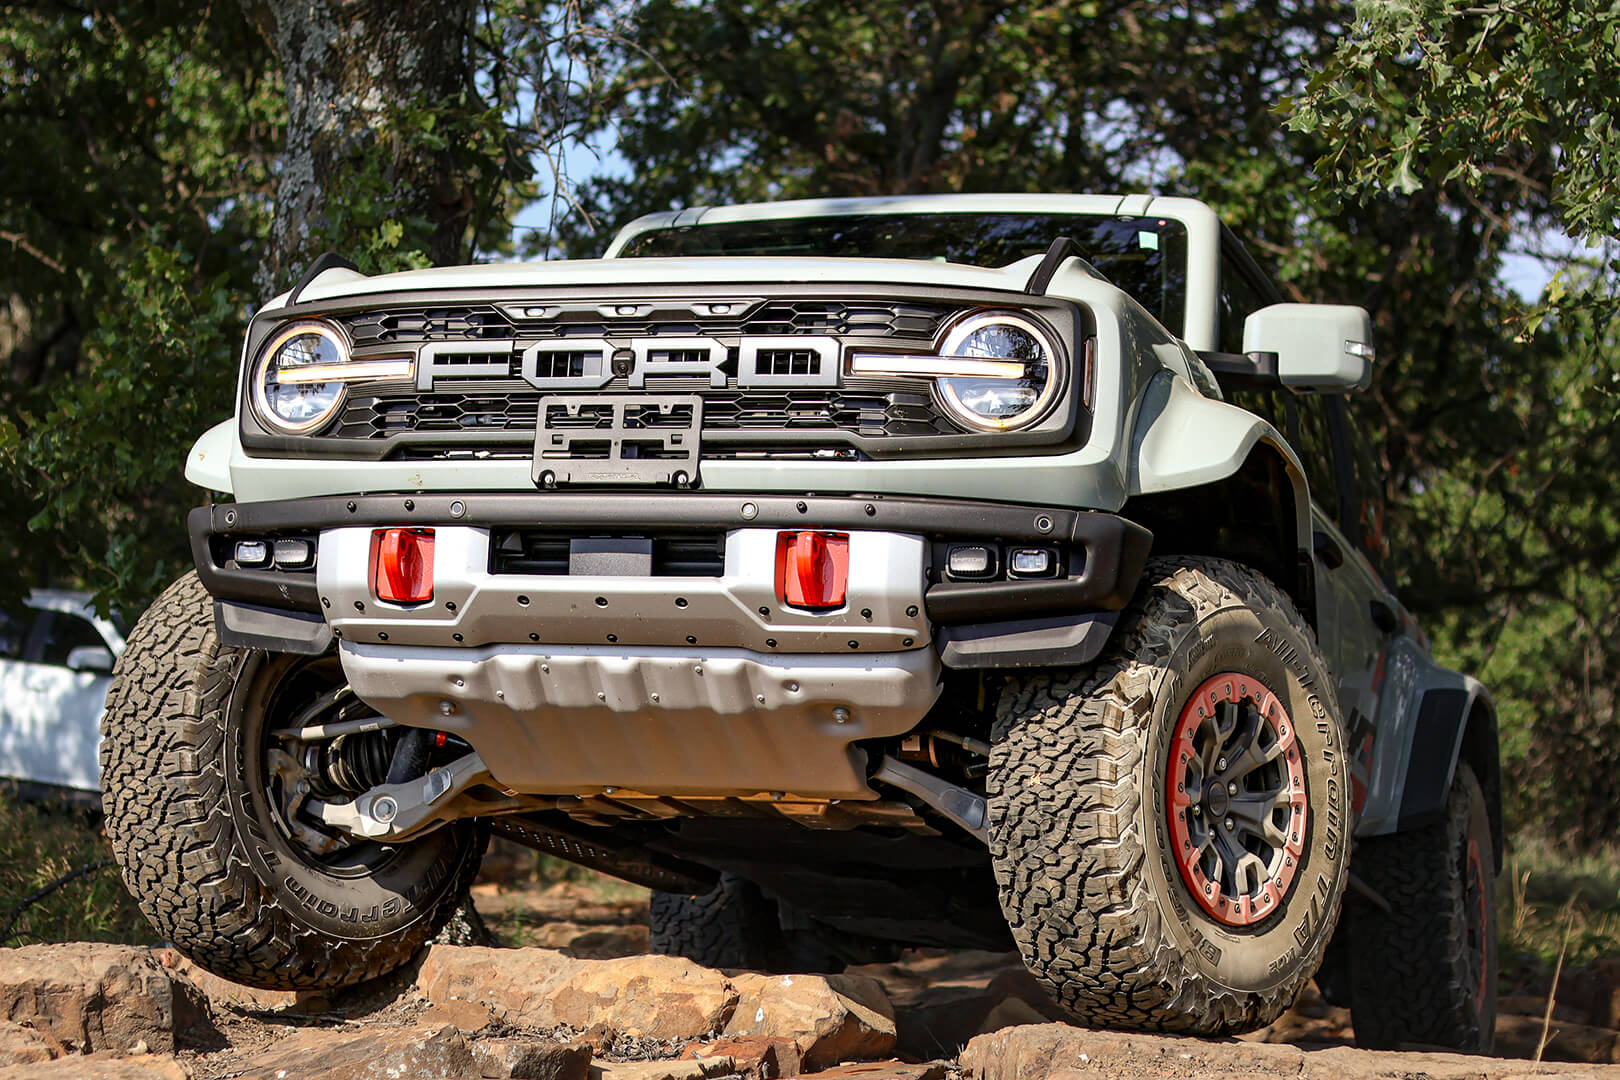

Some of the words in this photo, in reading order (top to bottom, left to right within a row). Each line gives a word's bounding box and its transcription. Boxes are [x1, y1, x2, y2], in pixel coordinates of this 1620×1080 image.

[416, 336, 843, 392] FORD
[1254, 627, 1342, 860] All-Terrain
[1293, 873, 1332, 948] T/A
